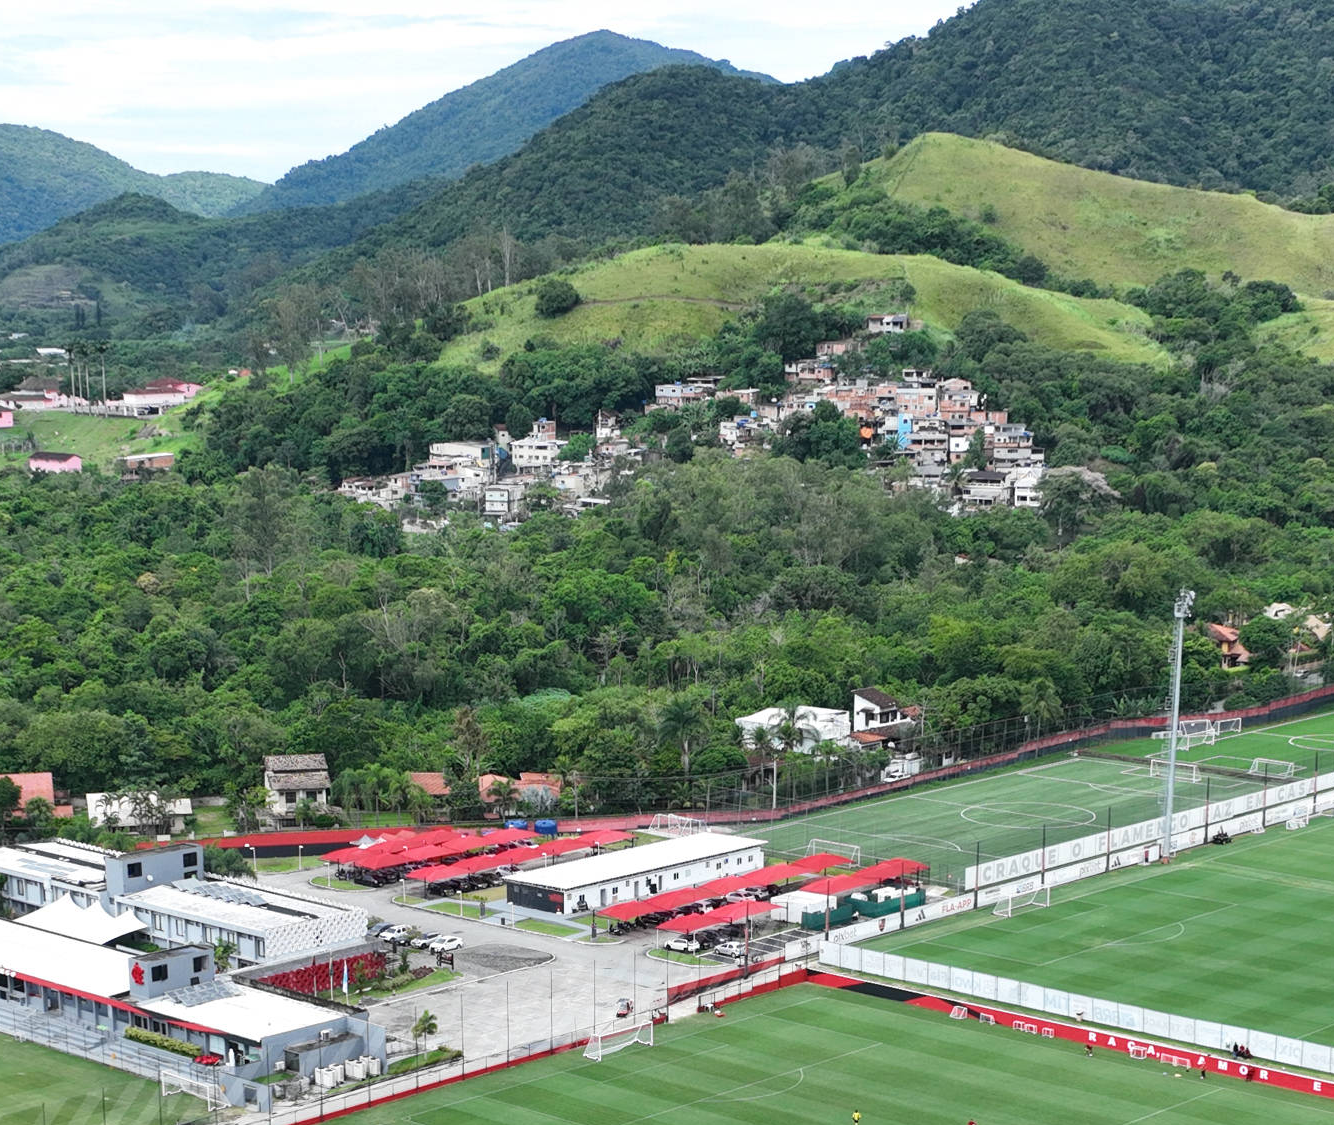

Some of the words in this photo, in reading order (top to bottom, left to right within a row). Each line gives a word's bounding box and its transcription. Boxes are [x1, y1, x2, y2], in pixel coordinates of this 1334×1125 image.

[982, 848, 1056, 882] CRAQUE
[1072, 842, 1082, 858] O
[1098, 814, 1188, 852] FLAMENGO
[941, 898, 972, 914] FLA-APP
[1197, 1056, 1269, 1080] AMOR
[1313, 1081, 1322, 1091] E
